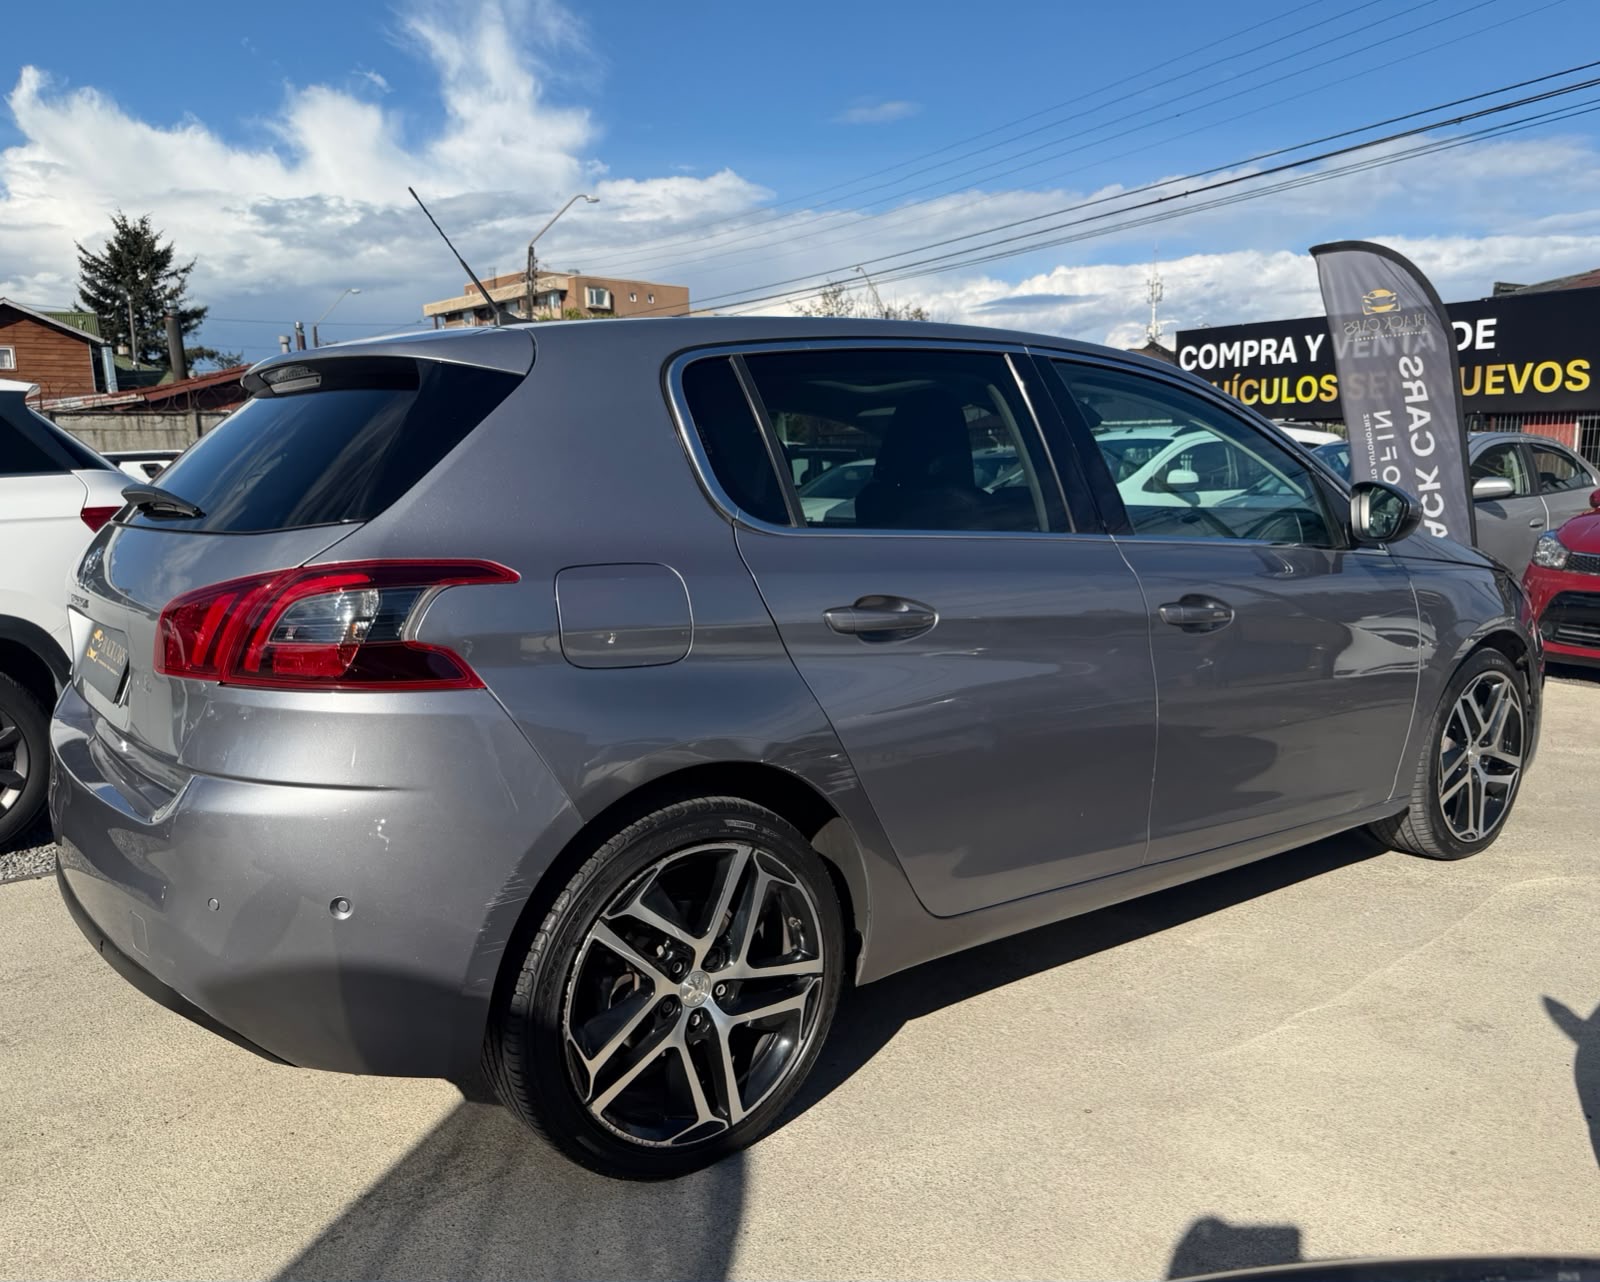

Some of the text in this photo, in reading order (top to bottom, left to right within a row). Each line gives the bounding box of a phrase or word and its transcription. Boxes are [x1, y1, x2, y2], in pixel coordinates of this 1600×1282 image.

[1179, 336, 1298, 371] COMPRA
[1304, 333, 1325, 362] Y
[1451, 318, 1497, 351] DE
[1211, 373, 1338, 405] ÍCULOS
